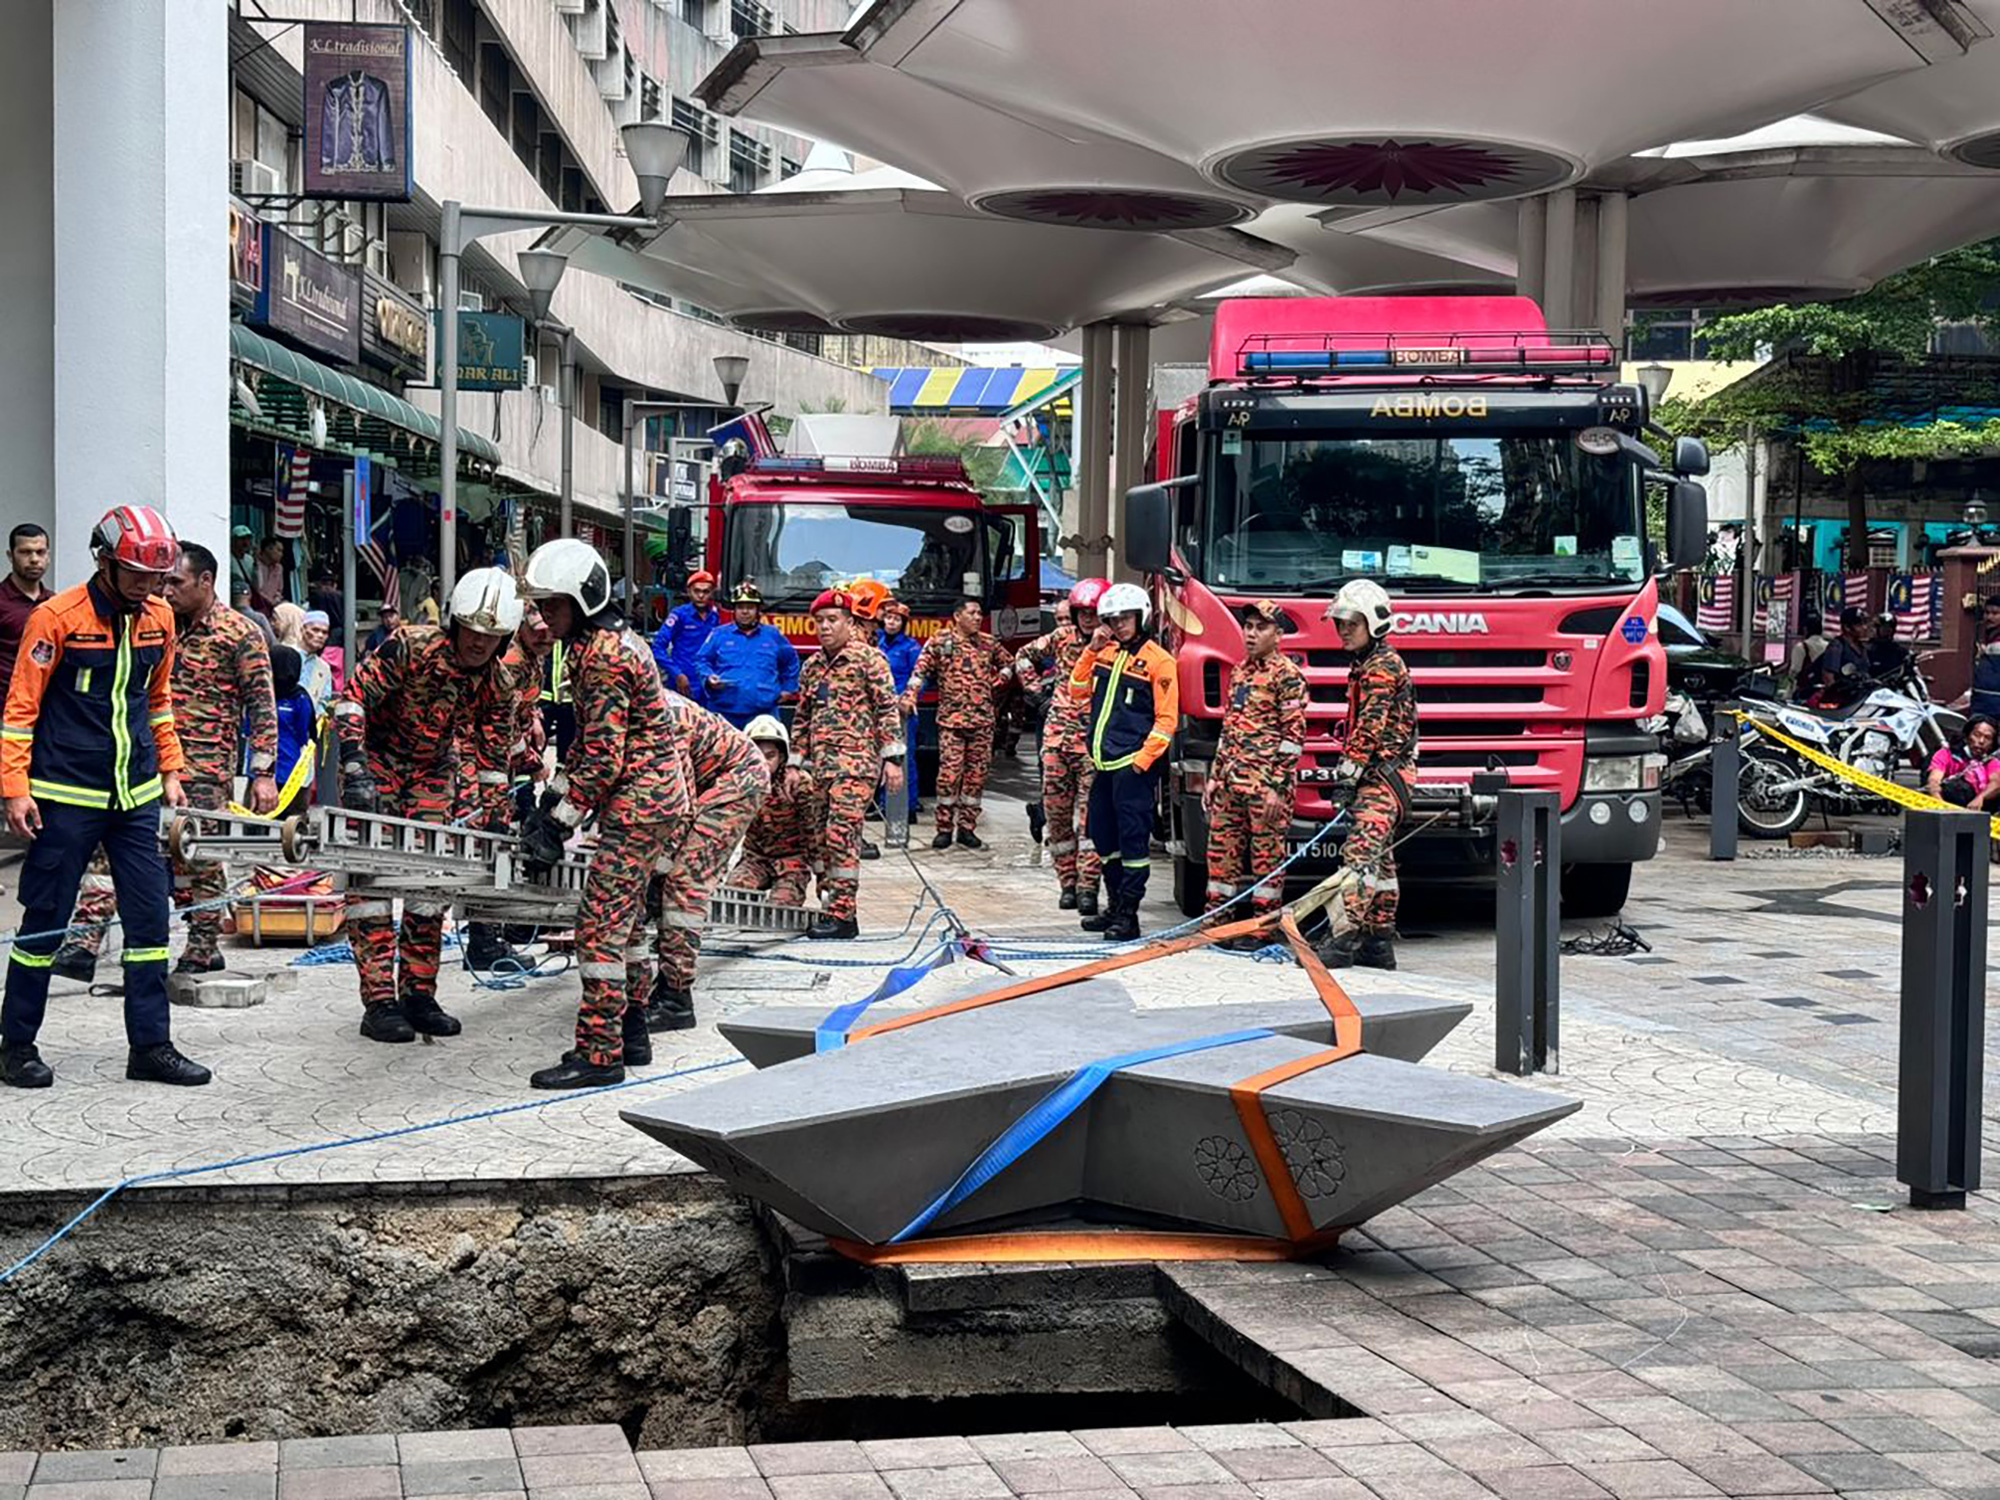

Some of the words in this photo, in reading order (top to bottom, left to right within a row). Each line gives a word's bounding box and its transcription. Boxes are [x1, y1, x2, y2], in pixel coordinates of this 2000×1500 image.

[1395, 349, 1461, 363] BOMBA
[492, 367, 518, 382] ALI
[849, 458, 896, 471] BOMBA
[1391, 612, 1489, 634] CANIA
[1301, 768, 1314, 781] P
